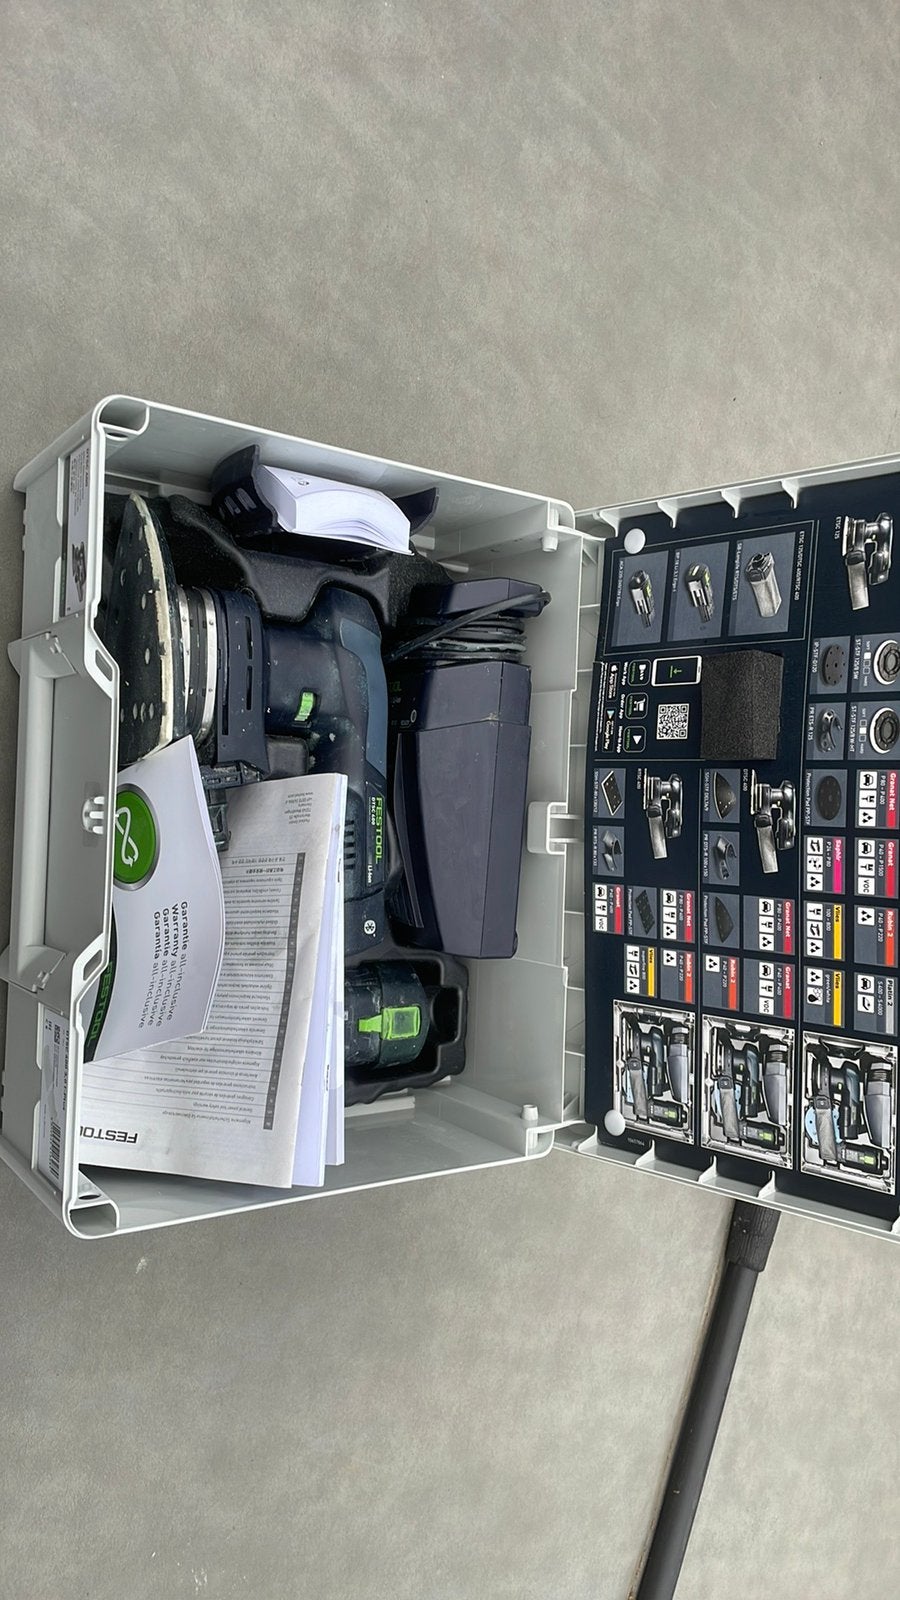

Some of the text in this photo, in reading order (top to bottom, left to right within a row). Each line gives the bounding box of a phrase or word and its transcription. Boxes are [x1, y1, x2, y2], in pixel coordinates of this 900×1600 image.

[809, 707, 814, 715] PR
[854, 672, 859, 680] SW
[375, 797, 383, 864] FESTOOL
[138, 962, 160, 1028] all-inclusive
[148, 908, 170, 1026] Garantie all-inclusive
[155, 904, 180, 1027] Warranty all-inclusive
[166, 901, 189, 1021] Garantie all-inclusive
[87, 961, 112, 1047] FESTOOL
